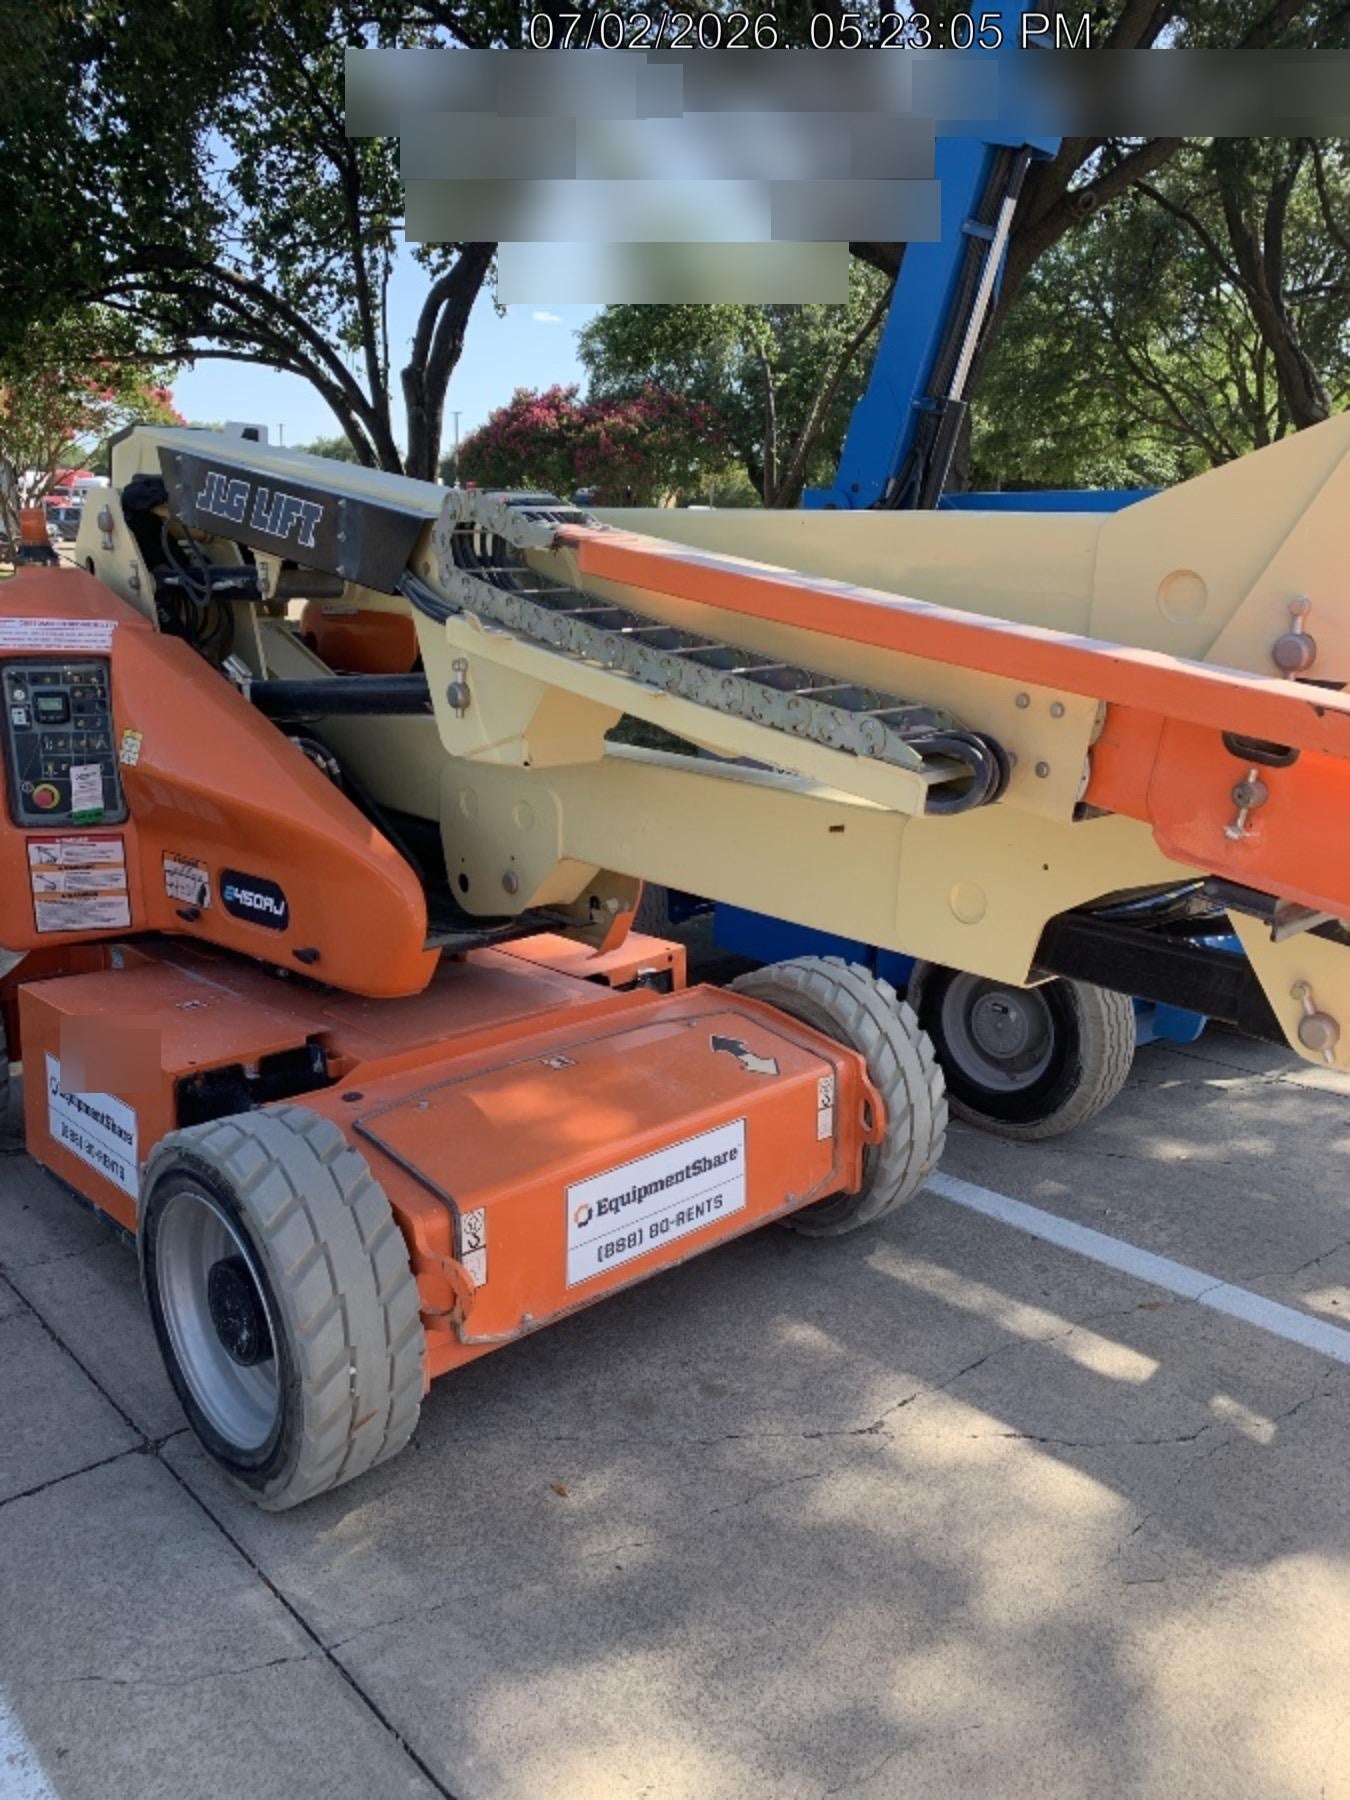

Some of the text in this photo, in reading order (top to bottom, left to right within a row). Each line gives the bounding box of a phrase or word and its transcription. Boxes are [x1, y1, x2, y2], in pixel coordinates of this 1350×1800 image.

[195, 471, 324, 548] JLG LIFT
[595, 1146, 738, 1217] EquipmentShare
[597, 1193, 724, 1263] (888) 80-RENTS
